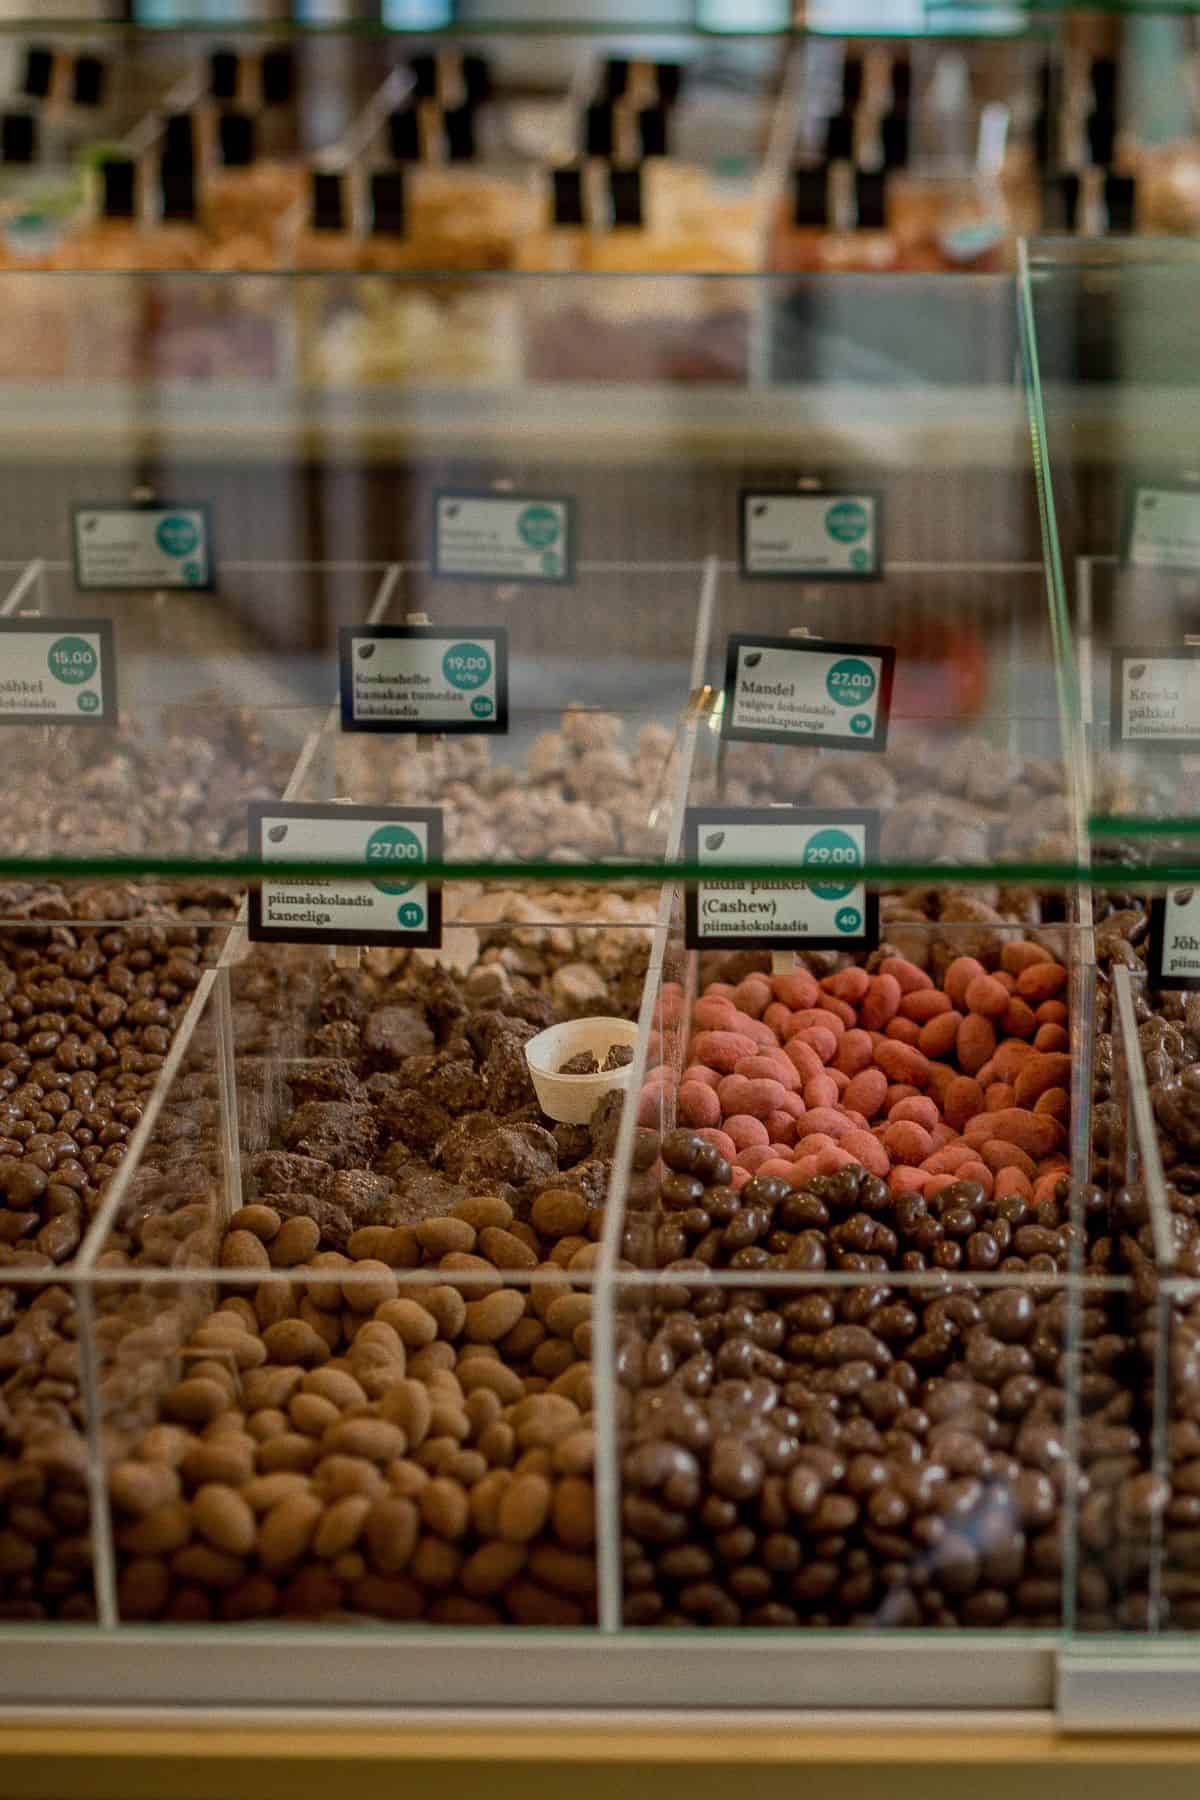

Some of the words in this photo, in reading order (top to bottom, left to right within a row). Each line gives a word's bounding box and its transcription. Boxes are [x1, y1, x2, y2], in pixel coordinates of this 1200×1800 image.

[447, 656, 487, 670] 19.00
[831, 672, 872, 687] 27.00
[740, 680, 795, 697] Mandel
[370, 843, 418, 858] 27.00
[807, 847, 856, 864] 29.00
[268, 892, 374, 907] piimašokolaadis
[702, 898, 777, 915] (Cashew)
[268, 909, 332, 925] kaneeliga
[404, 910, 418, 921] 11
[840, 914, 857, 926] 40
[703, 919, 809, 934] piimašokolaadis
